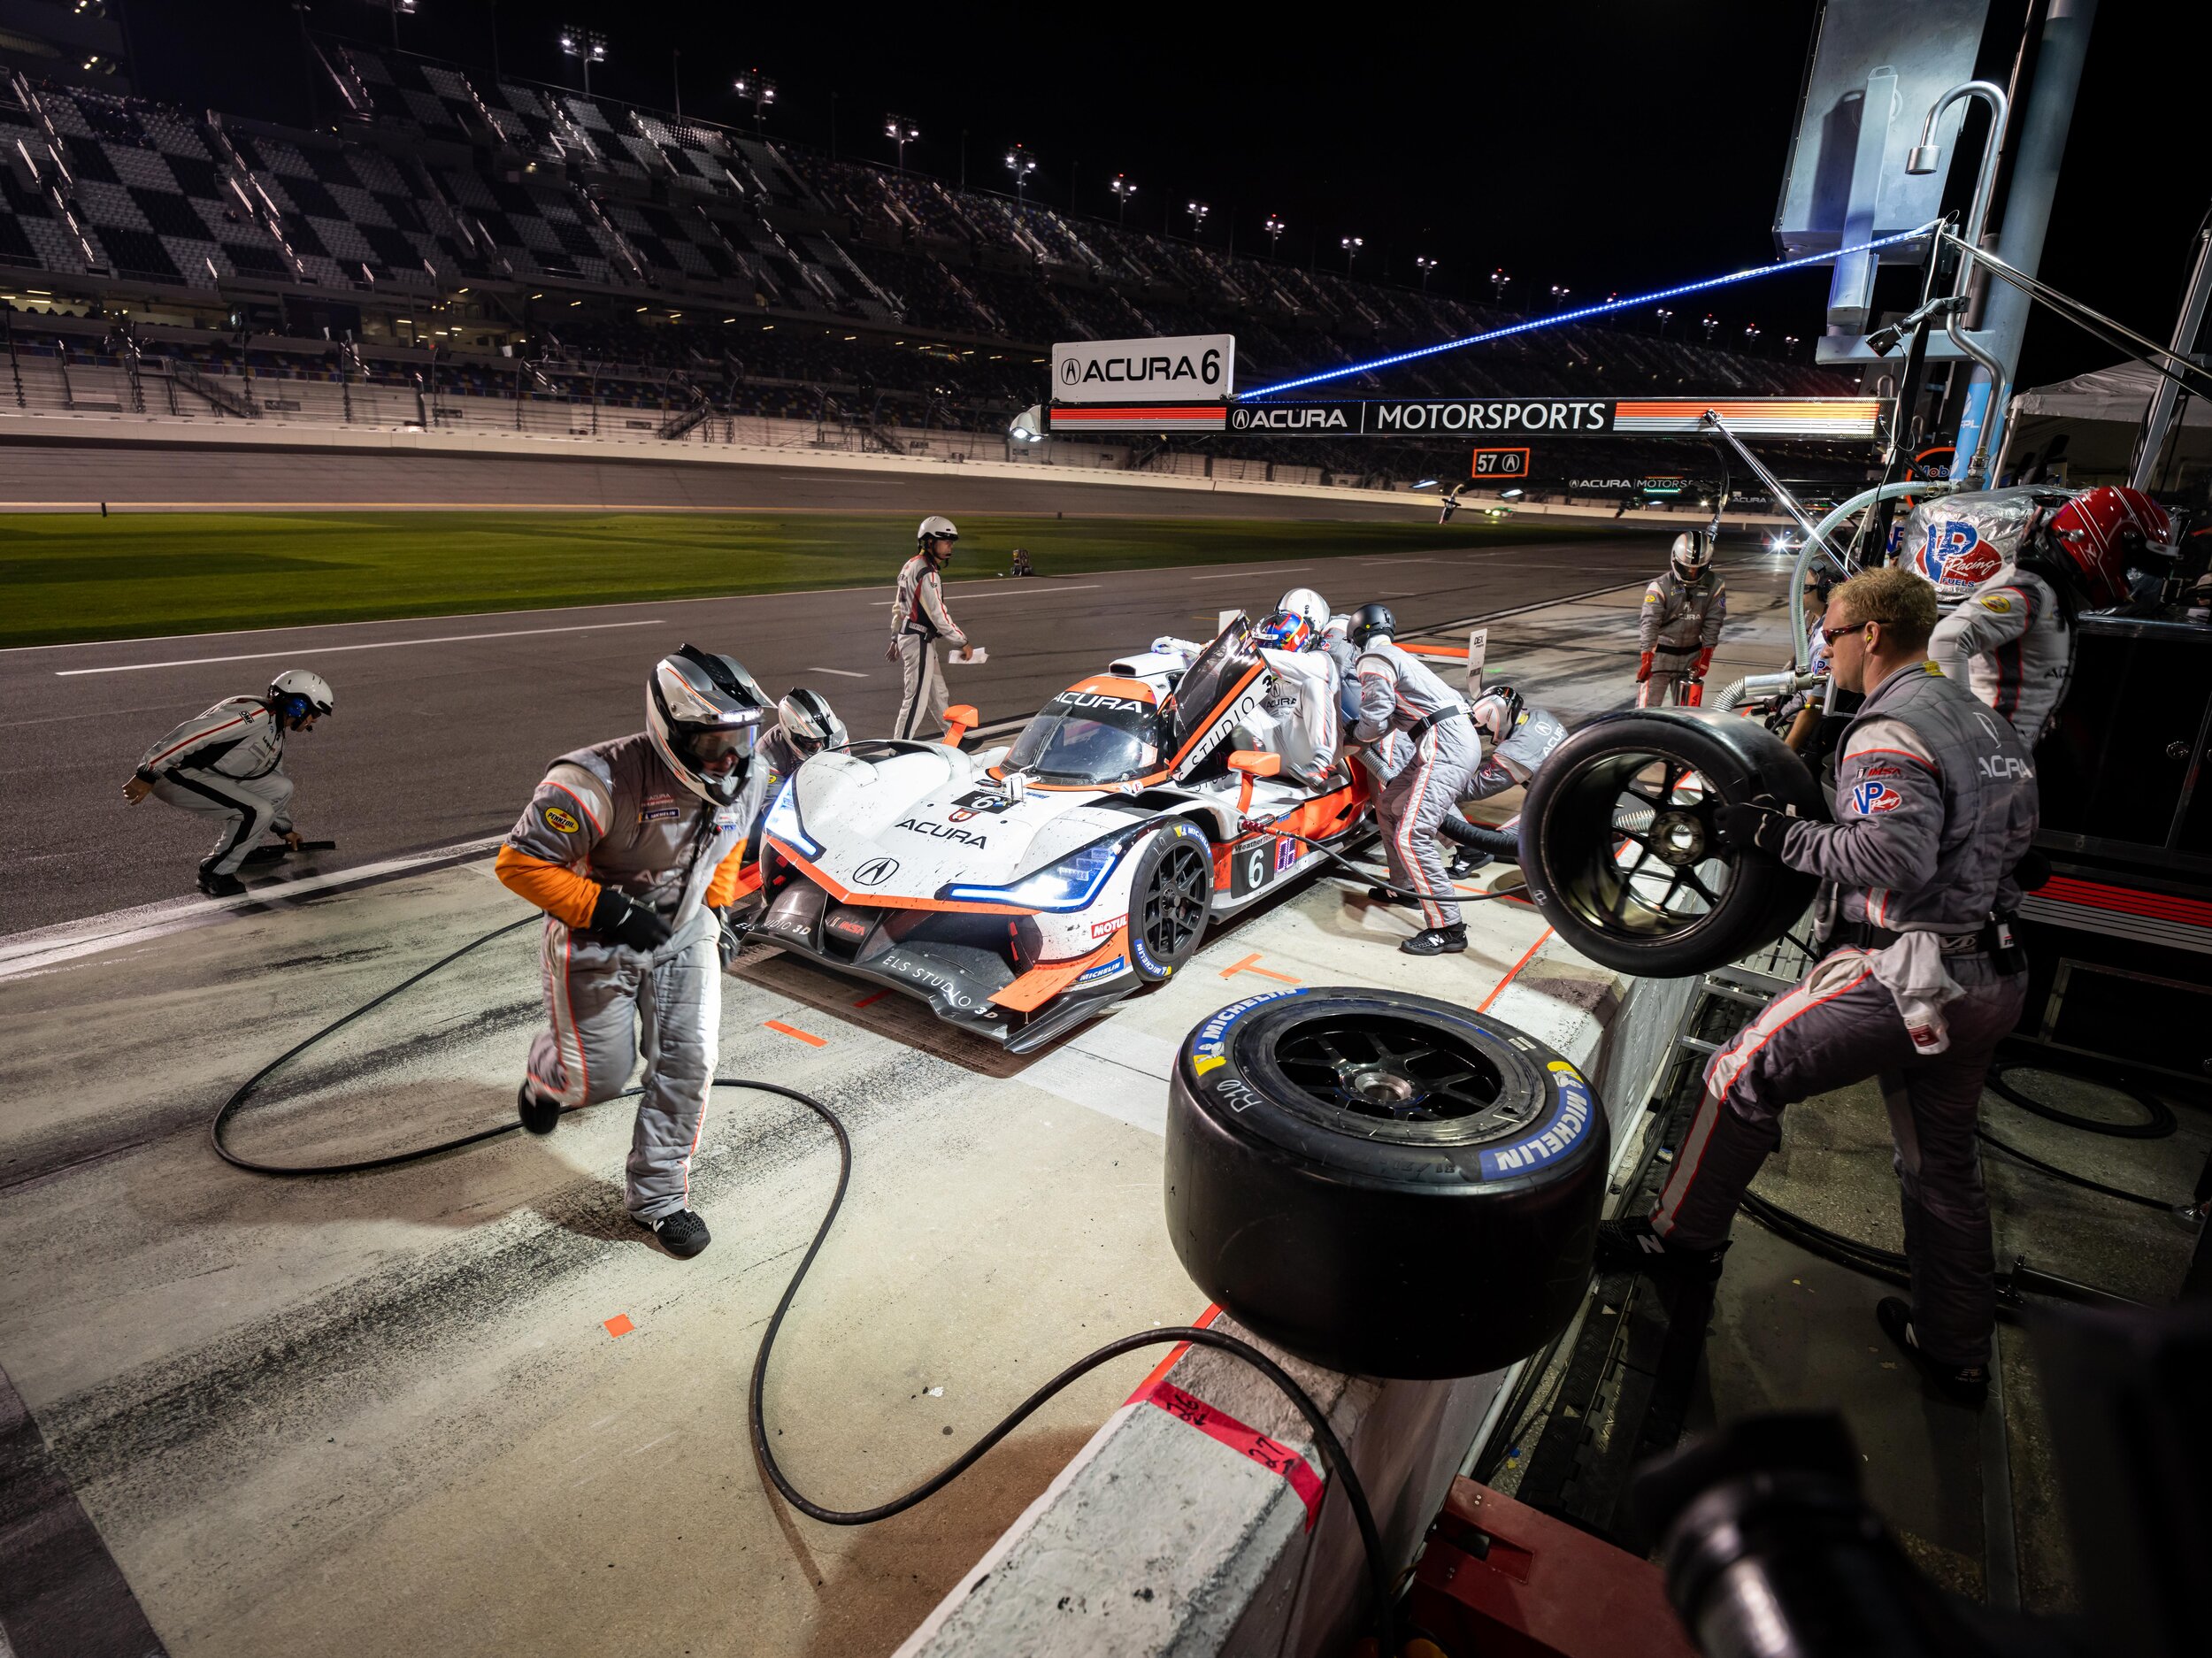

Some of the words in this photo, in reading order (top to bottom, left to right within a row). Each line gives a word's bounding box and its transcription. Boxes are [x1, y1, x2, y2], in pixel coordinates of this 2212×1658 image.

[1082, 356, 1197, 383] ACURA
[1201, 349, 1220, 385] 6
[1249, 409, 1348, 428] ACURA
[1378, 402, 1607, 431] MOTORSPORTS
[1477, 454, 1498, 473] 57
[1915, 465, 1951, 478] Mob
[1579, 480, 1632, 488] ACURA
[1926, 519, 1979, 585] VP
[1943, 557, 2003, 577] Racing
[1942, 577, 1976, 587] FUELS
[1050, 691, 1142, 714] ACURA
[1266, 697, 1298, 709] ACURA
[241, 710, 253, 725] OMP
[1978, 755, 2034, 779] ACRA
[971, 796, 1002, 810] 6
[1854, 782, 1885, 814] VP
[547, 811, 576, 829] PENNZOIL
[650, 810, 677, 820] MICHELIN
[894, 818, 987, 850] ACURA
[1187, 826, 1212, 856] MICHELIN
[1248, 848, 1264, 889] 6
[792, 924, 810, 936] 3D
[1094, 915, 1128, 938] MOTUL
[1136, 943, 1163, 975] MICHELIN
[1079, 961, 1122, 982] MICHELIN
[882, 956, 911, 972] ELS
[912, 967, 972, 1008] STUDIO
[974, 1005, 999, 1019] 3D
[1202, 988, 1297, 1040] MICHELIN
[1494, 1089, 1588, 1171] MICHELIN
[1166, 1393, 1201, 1422] 26
[1248, 1436, 1286, 1469] 27
